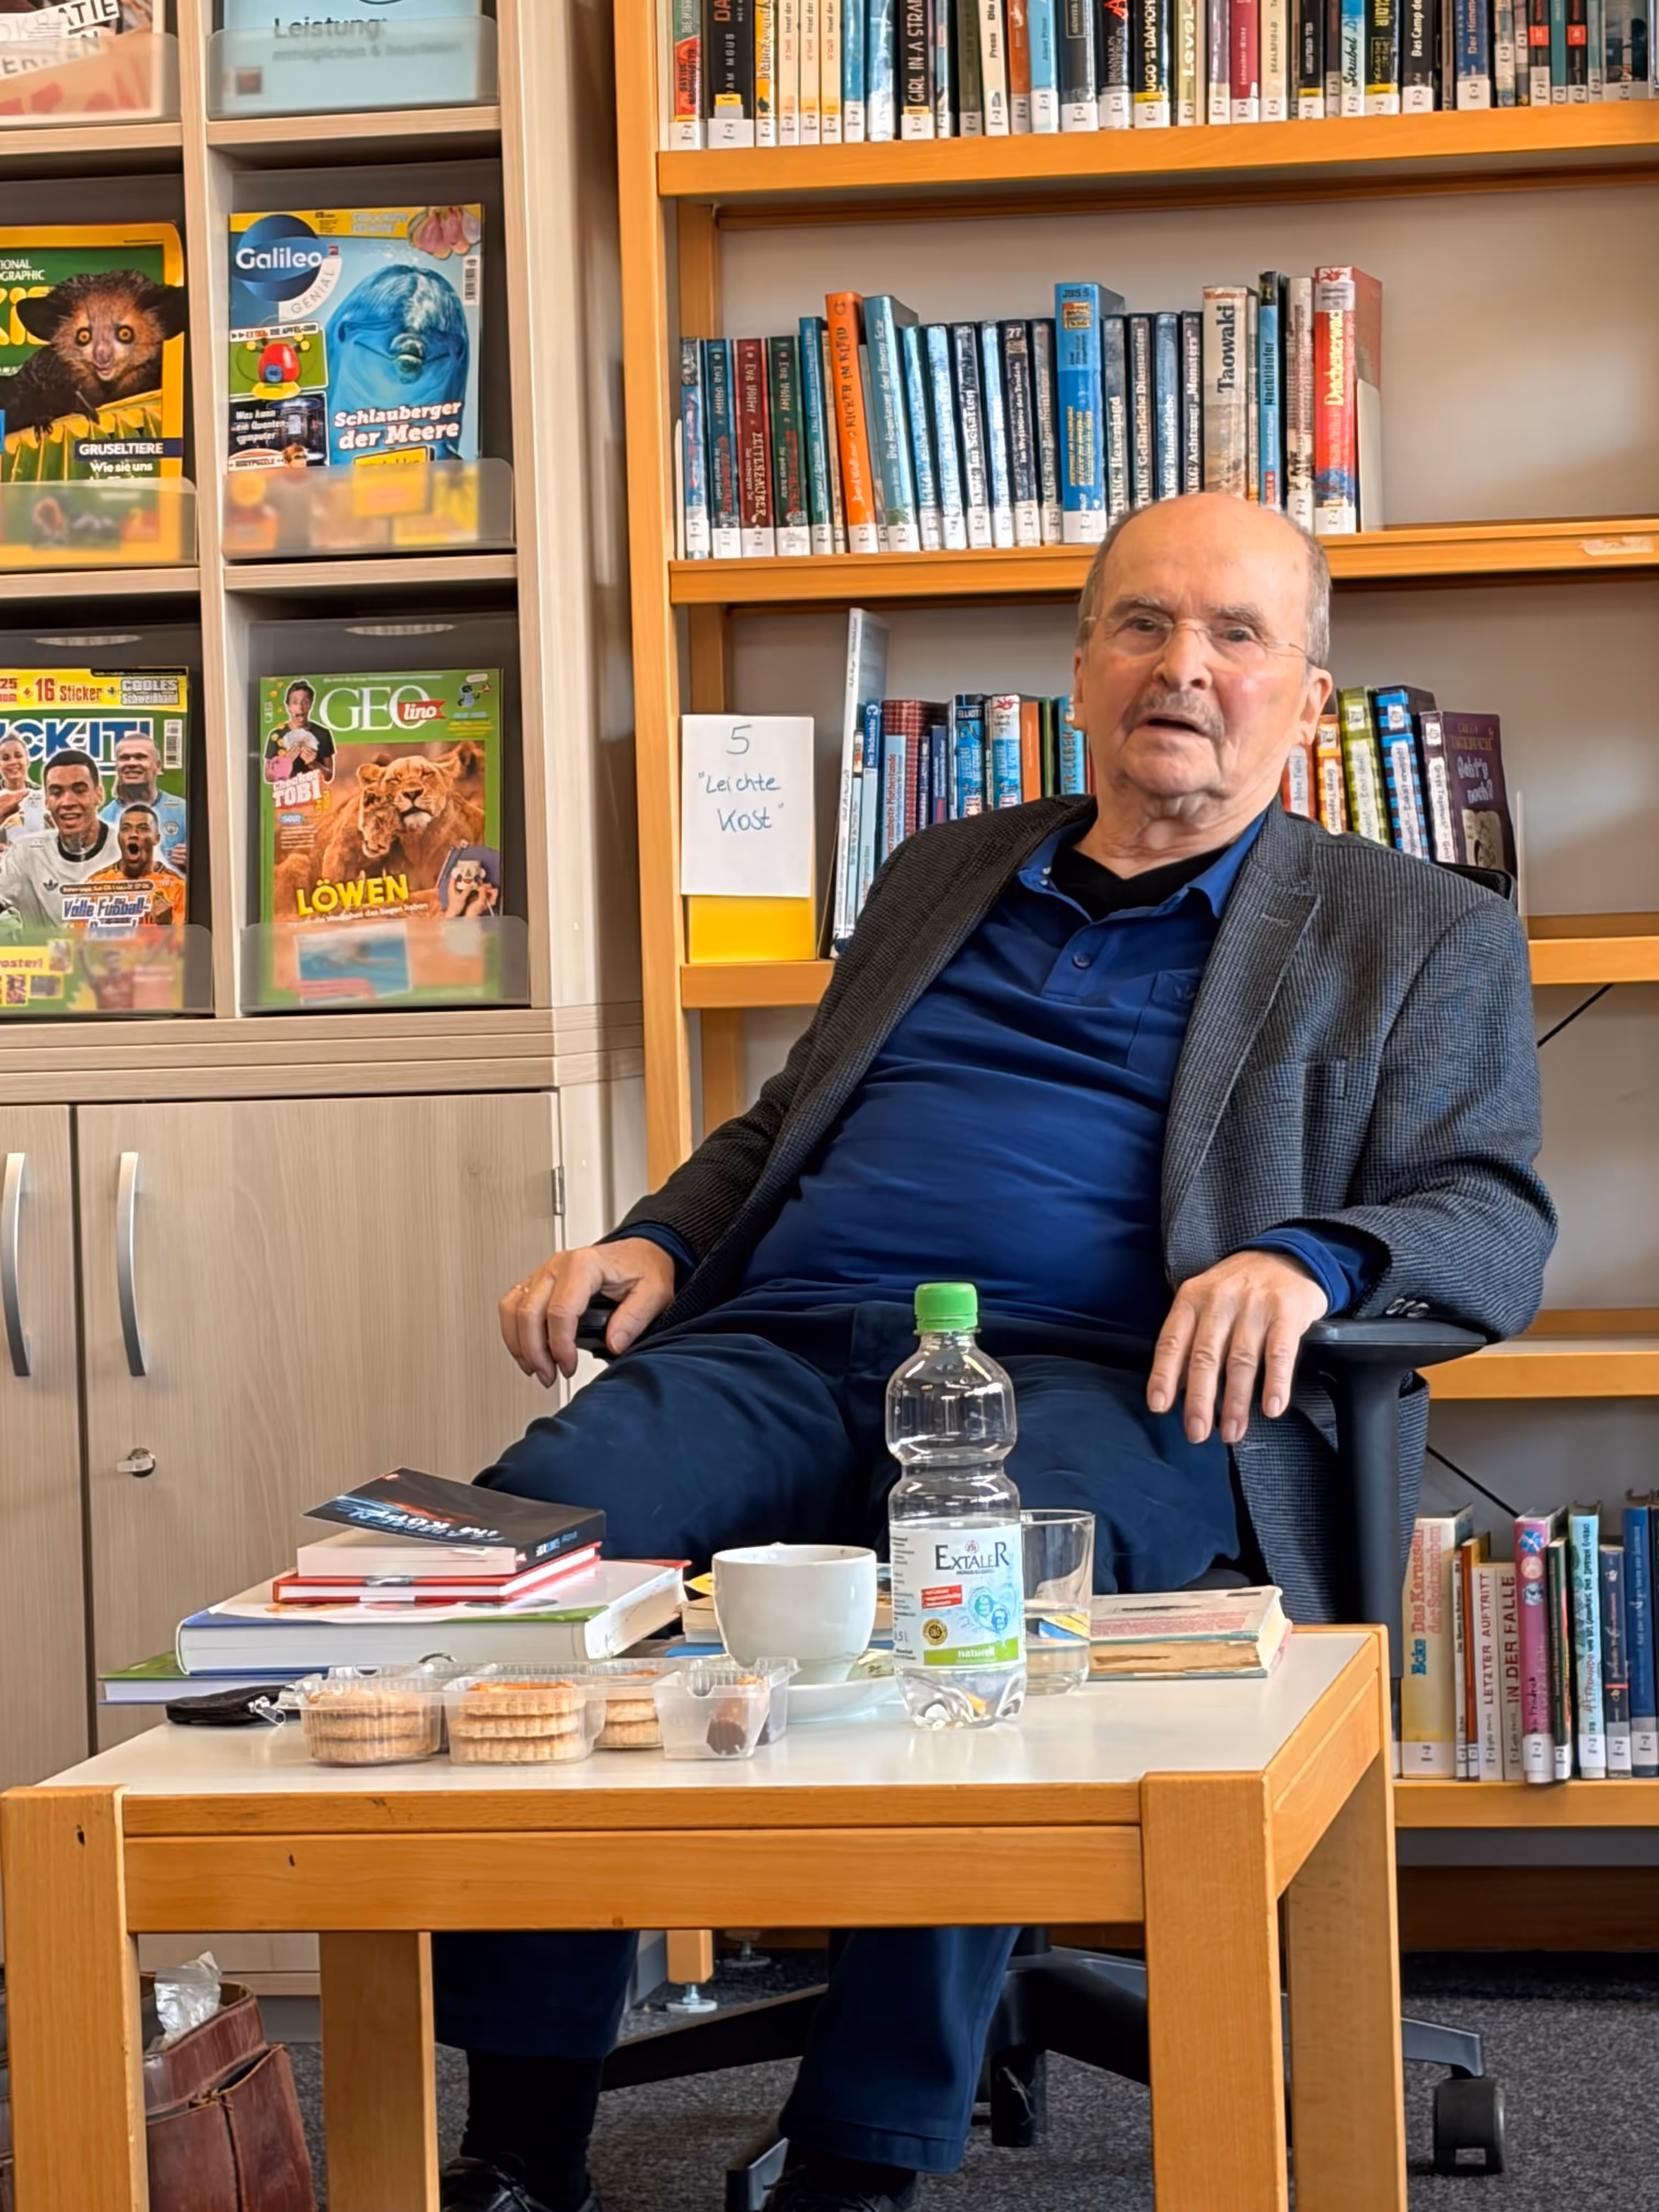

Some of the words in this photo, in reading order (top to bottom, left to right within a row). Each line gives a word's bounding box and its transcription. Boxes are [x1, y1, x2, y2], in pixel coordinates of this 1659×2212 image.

[1412, 12, 1424, 38] Camp
[908, 42, 924, 52] A
[1412, 40, 1422, 57] Das
[1467, 36, 1477, 55] Der
[908, 57, 924, 69] IN
[908, 76, 924, 102] GIRL
[236, 247, 323, 269] Galileo
[0, 269, 46, 281] GRAPHIC
[291, 268, 335, 313] GENIAL
[1136, 329, 1146, 394] Diamanten
[1217, 305, 1235, 393] Taowaki
[713, 366, 723, 383] Eva
[746, 364, 757, 381] Eva
[780, 362, 789, 379] Eva
[879, 374, 890, 390] der
[335, 401, 462, 427] Schlauberger
[840, 384, 856, 428] KICKER
[338, 430, 380, 449] der
[385, 422, 459, 445] Meere
[1109, 397, 1124, 468] Hexenjagd
[79, 443, 163, 455] GRUSELTIERE
[886, 443, 898, 459] Die
[90, 461, 112, 472] Wie
[114, 461, 130, 471] sie
[752, 431, 766, 517] ZEITENZAUBER
[1186, 466, 1199, 493] KKG
[1164, 469, 1176, 499] KKG
[36, 678, 55, 702] 16
[59, 685, 102, 702] Sticker
[122, 680, 178, 691] COOLES
[319, 685, 431, 732] GEO
[403, 703, 438, 721] lino
[725, 724, 753, 755] 5
[867, 754, 876, 766] Der
[274, 782, 322, 808] TOBI
[297, 873, 409, 916] LÖWEN
[935, 1542, 1010, 1570] EXTALER
[1479, 1573, 1491, 1637] AUFTRITT
[1502, 1576, 1517, 1634] FALLE
[1410, 1605, 1425, 1633] Das
[1427, 1610, 1442, 1633] der
[958, 1646, 995, 1658] naturell
[1411, 1639, 1426, 1675] Ecke
[1504, 1641, 1519, 1679] DER
[1482, 1645, 1493, 1705] LETZTER
[1506, 1686, 1519, 1703] IN
